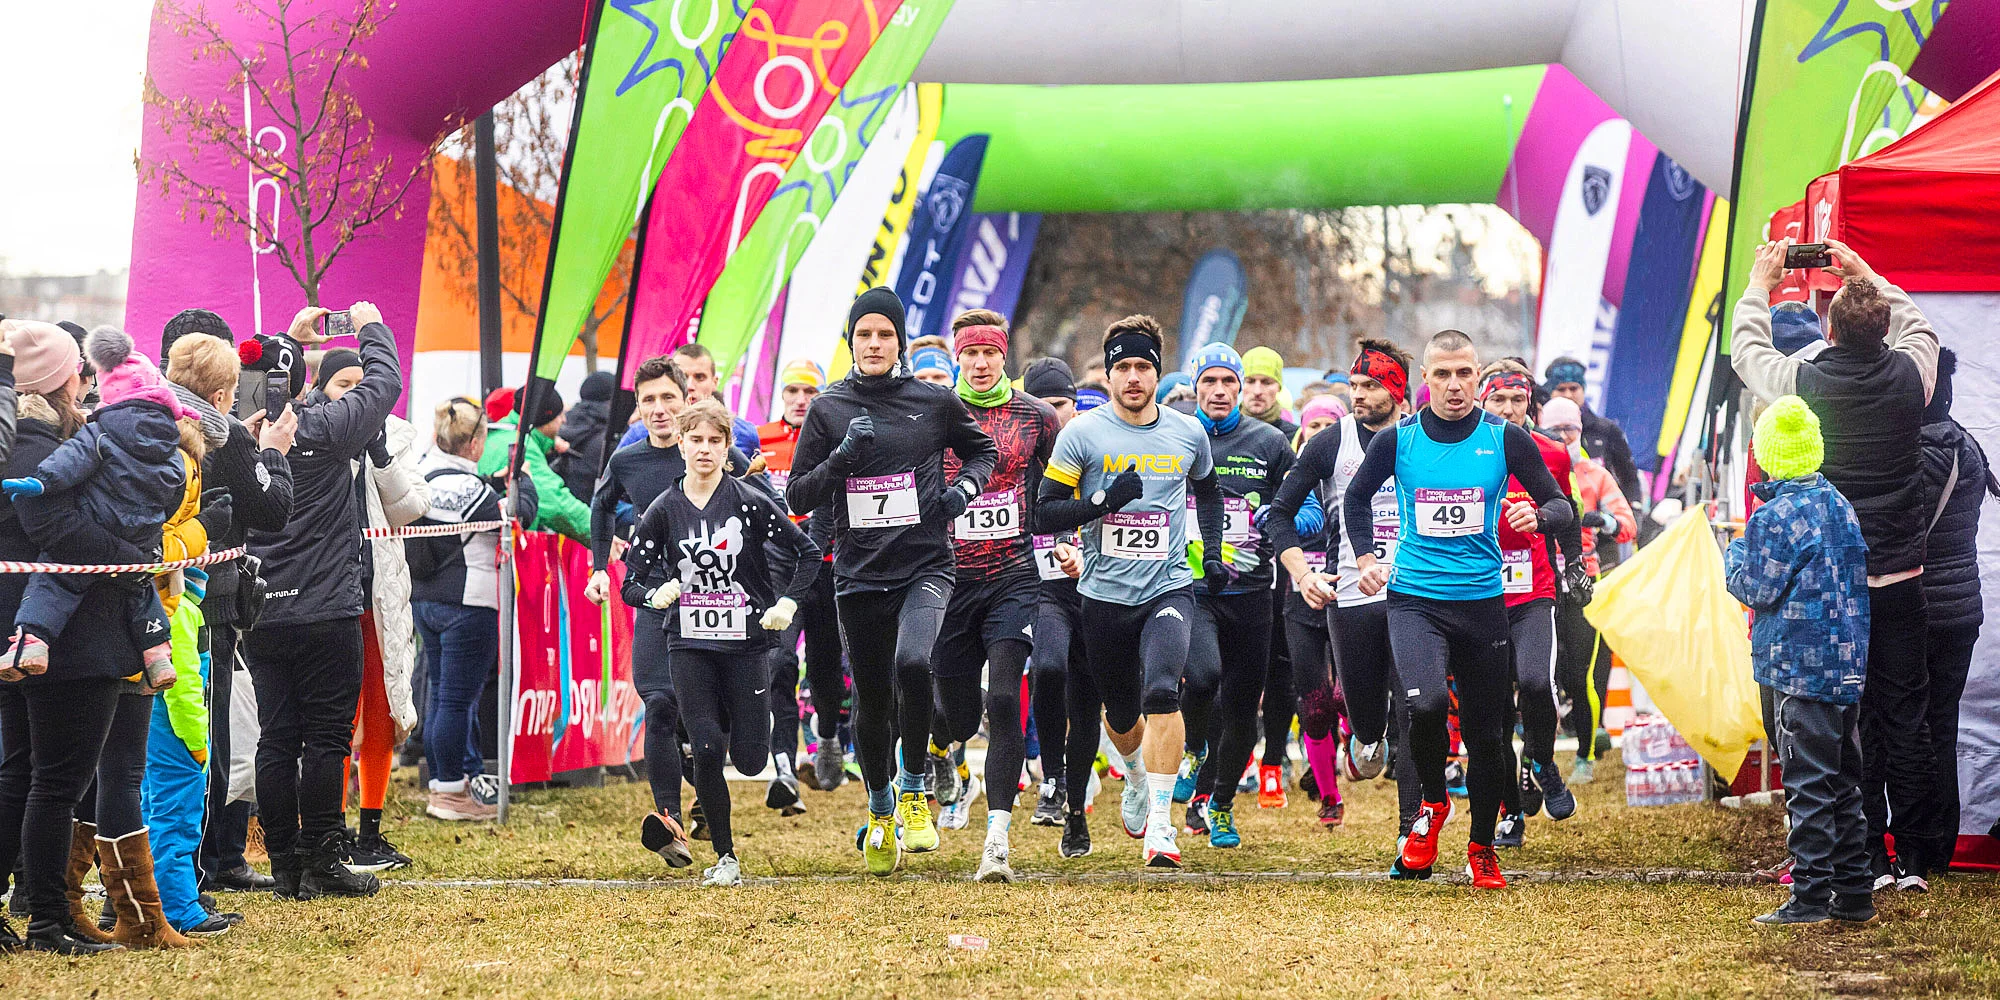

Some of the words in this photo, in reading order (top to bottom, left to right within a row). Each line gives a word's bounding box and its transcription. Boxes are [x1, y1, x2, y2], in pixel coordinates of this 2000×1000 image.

[1103, 453, 1185, 474] MOREK
[1246, 467, 1268, 477] RUN
[888, 481, 904, 489] RUN
[872, 494, 889, 515] 7
[964, 507, 1010, 529] 130
[1144, 518, 1159, 526] RUN
[1432, 505, 1467, 525] 49
[1112, 527, 1160, 549] 129
[1043, 550, 1056, 569] 1
[1373, 541, 1387, 560] 5
[1502, 565, 1512, 583] 1
[689, 609, 733, 629] 101
